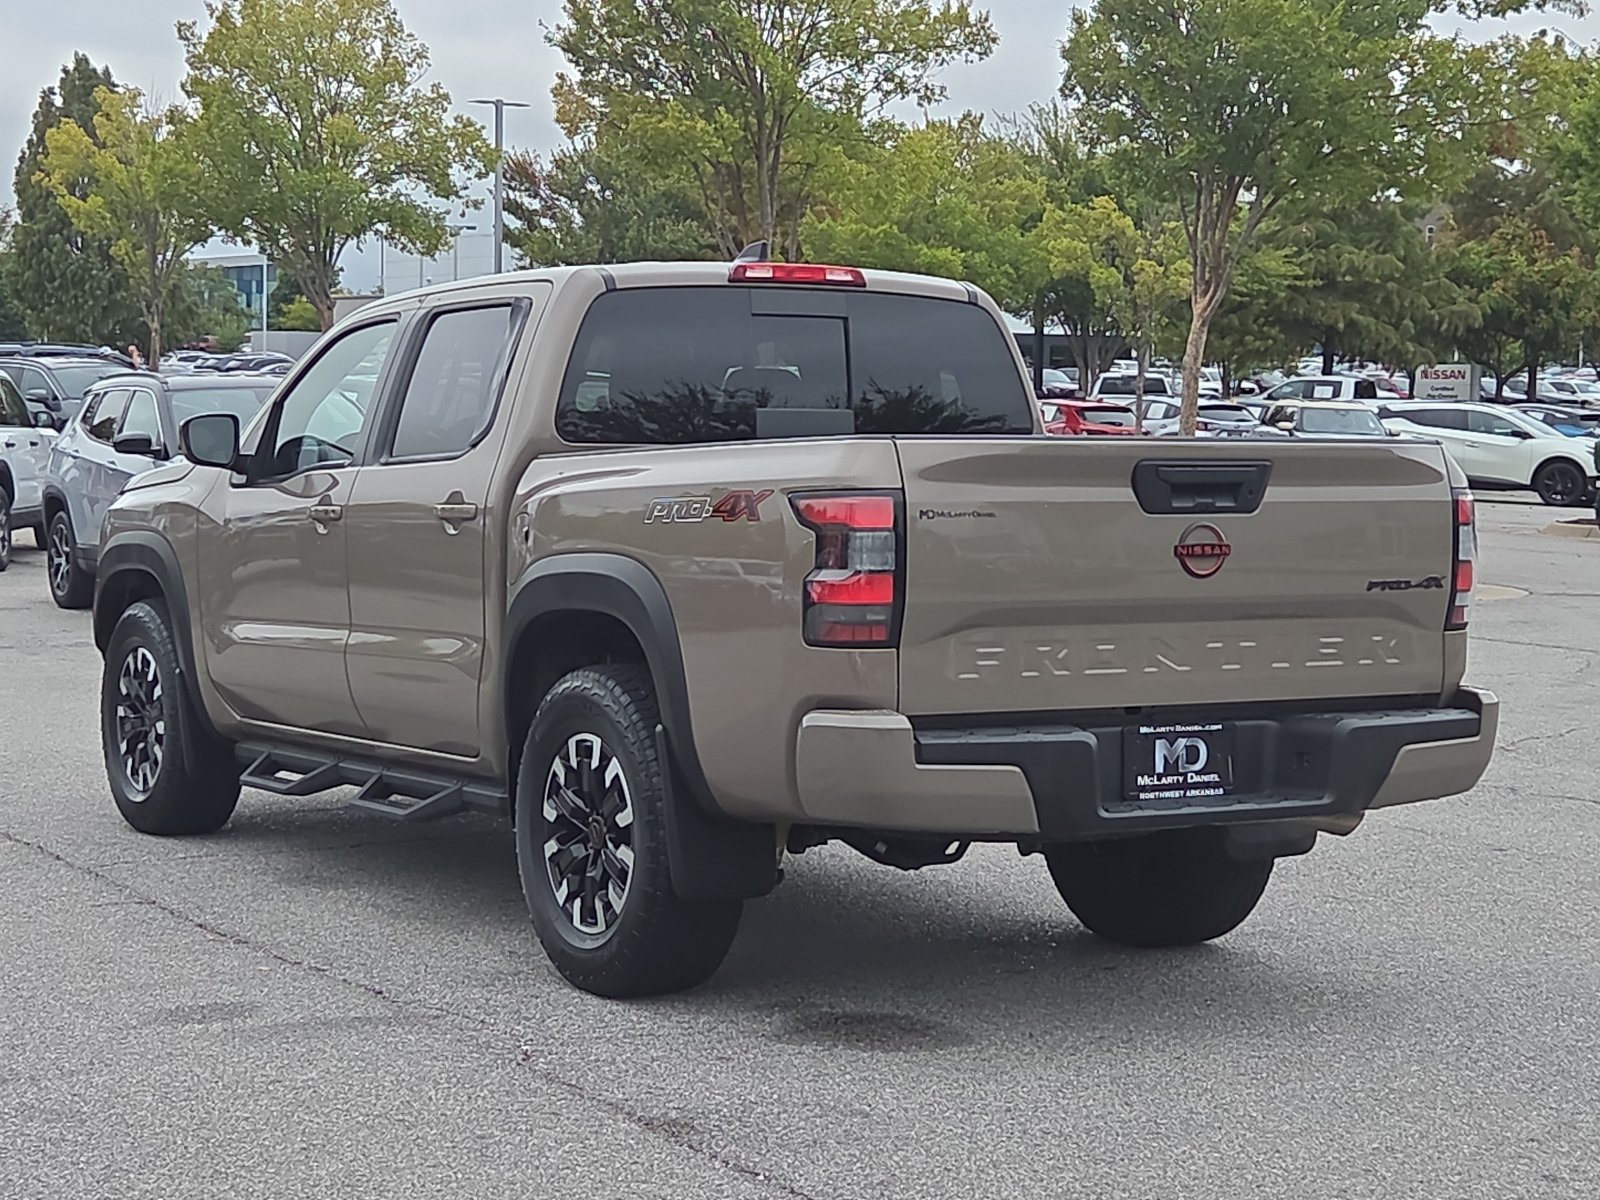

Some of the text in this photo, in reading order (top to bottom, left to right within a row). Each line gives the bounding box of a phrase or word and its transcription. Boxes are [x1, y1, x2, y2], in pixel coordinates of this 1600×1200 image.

[1420, 369, 1466, 380] NISSAN
[1177, 545, 1230, 555] NISSAN
[1155, 737, 1208, 774] MD
